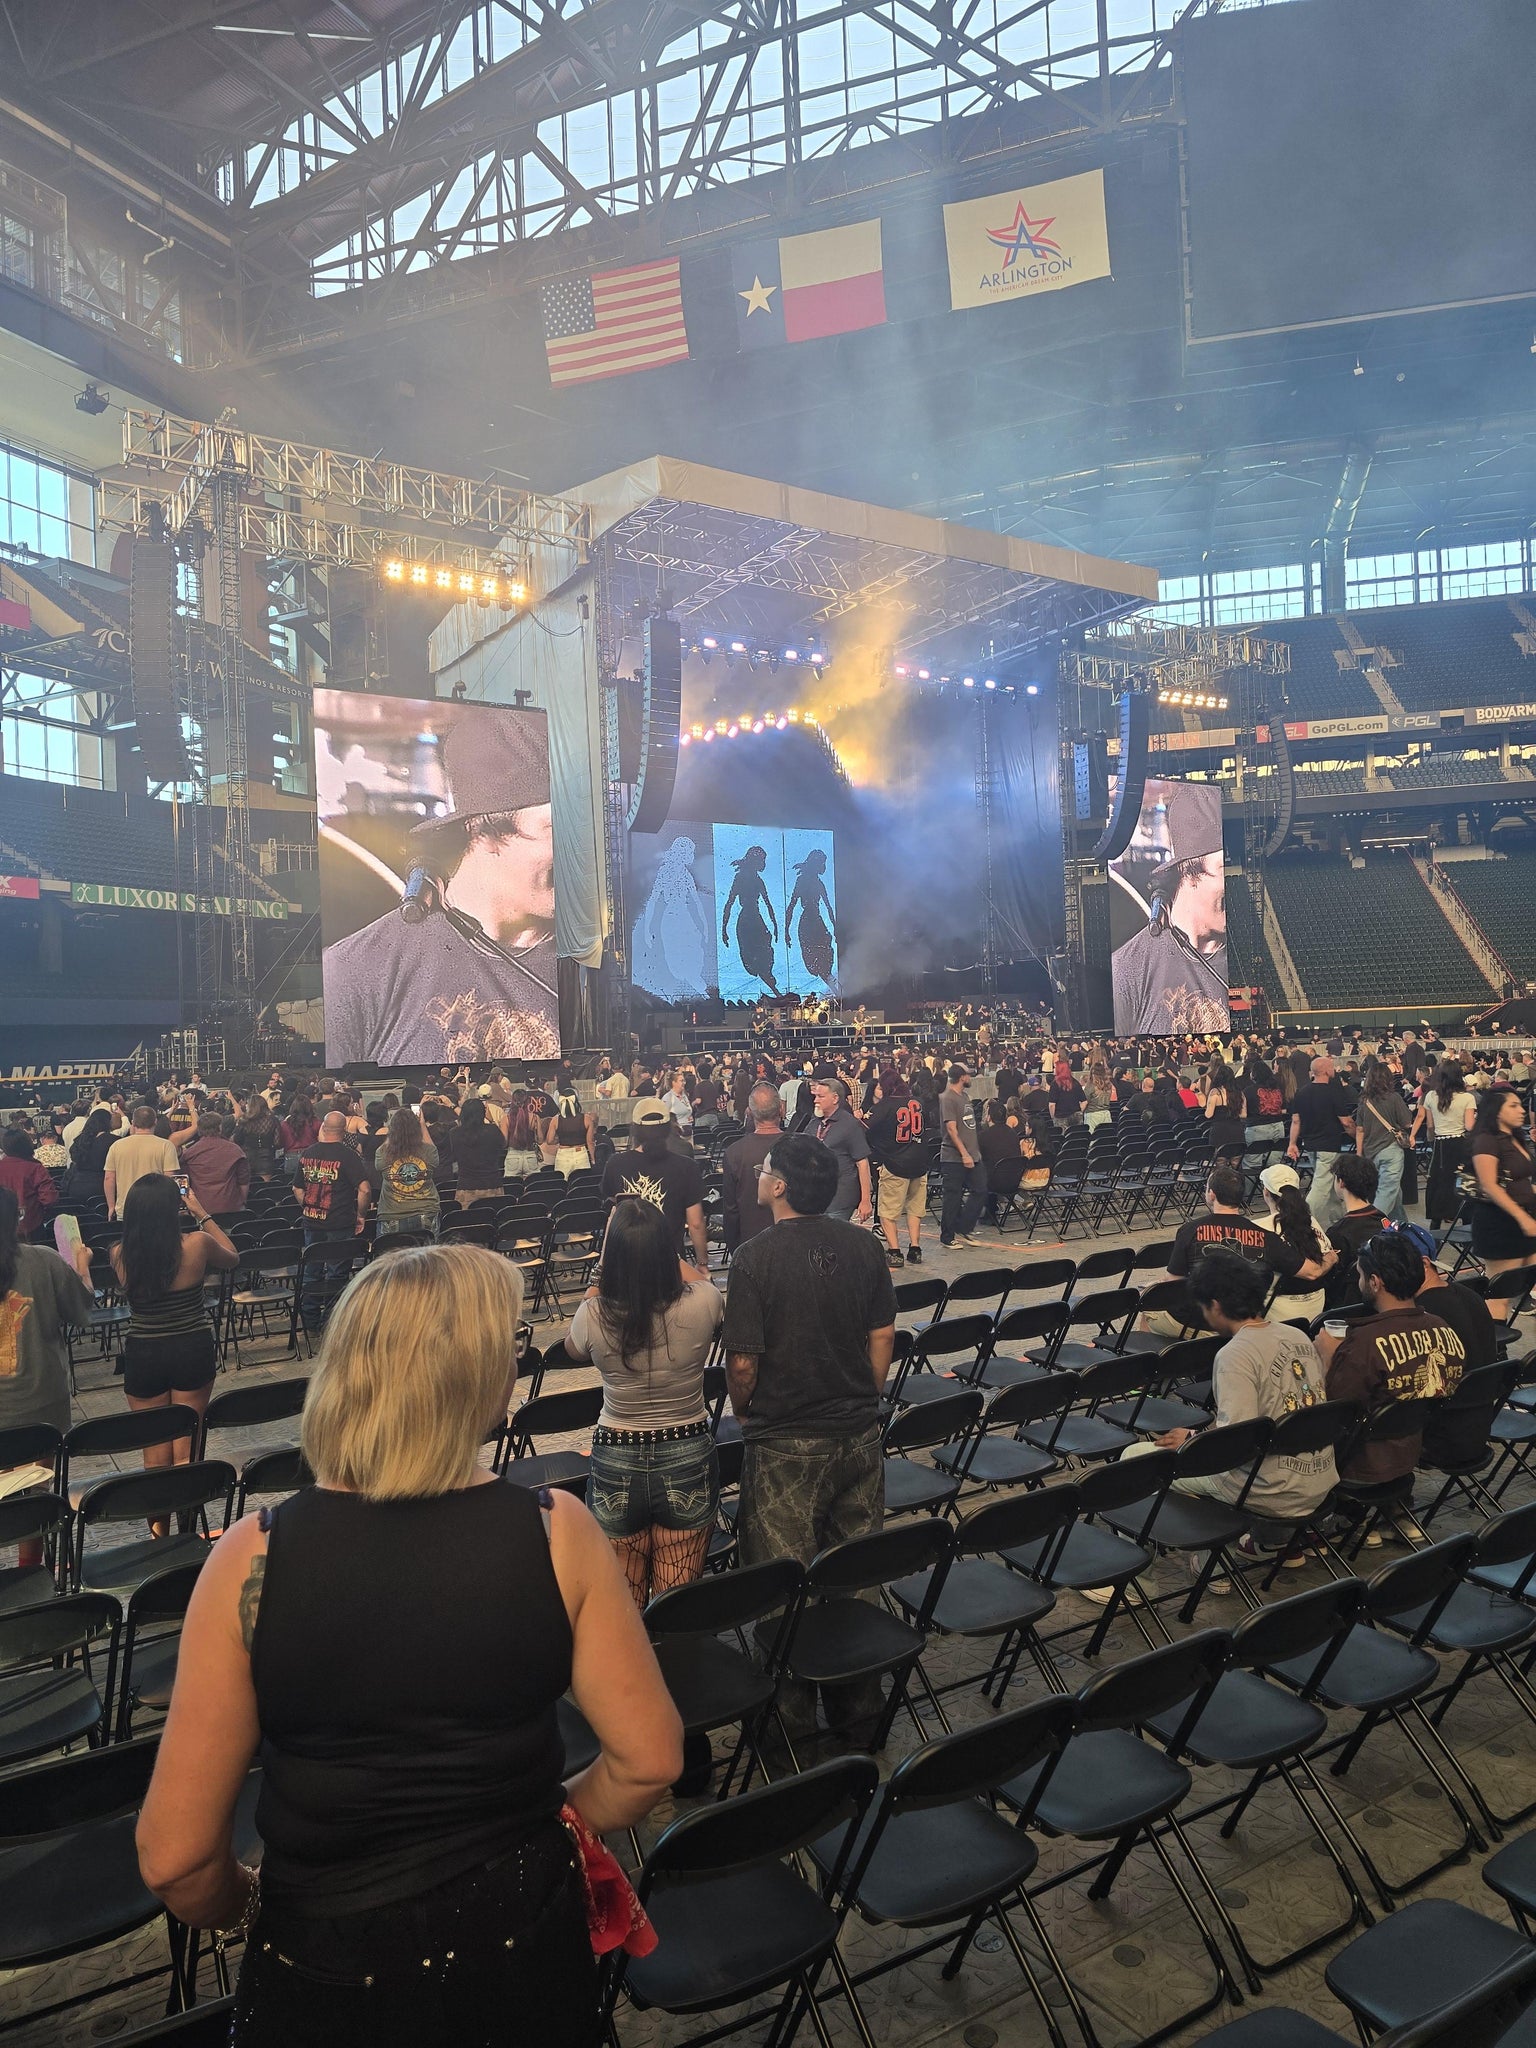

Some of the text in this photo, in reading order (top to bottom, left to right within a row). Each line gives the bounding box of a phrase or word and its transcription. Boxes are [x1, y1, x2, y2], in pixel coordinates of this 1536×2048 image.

[979, 257, 1073, 289] ARLINGTON
[1001, 281, 1029, 293] AMERICAN
[1030, 277, 1049, 286] DREAM
[269, 682, 275, 690] &
[276, 683, 313, 700] RESORTS
[1476, 704, 1536, 720] BODYARM
[1311, 721, 1384, 735] GoPGL.com
[1403, 715, 1437, 728] PGL
[96, 884, 178, 911] LUXOR
[11, 1063, 115, 1079] MARTIN
[896, 1099, 924, 1144] 26
[1196, 1224, 1222, 1243] GUNS
[1235, 1228, 1265, 1248] ROSES
[1375, 1327, 1466, 1372] COLORADO
[1387, 1374, 1412, 1390] EST
